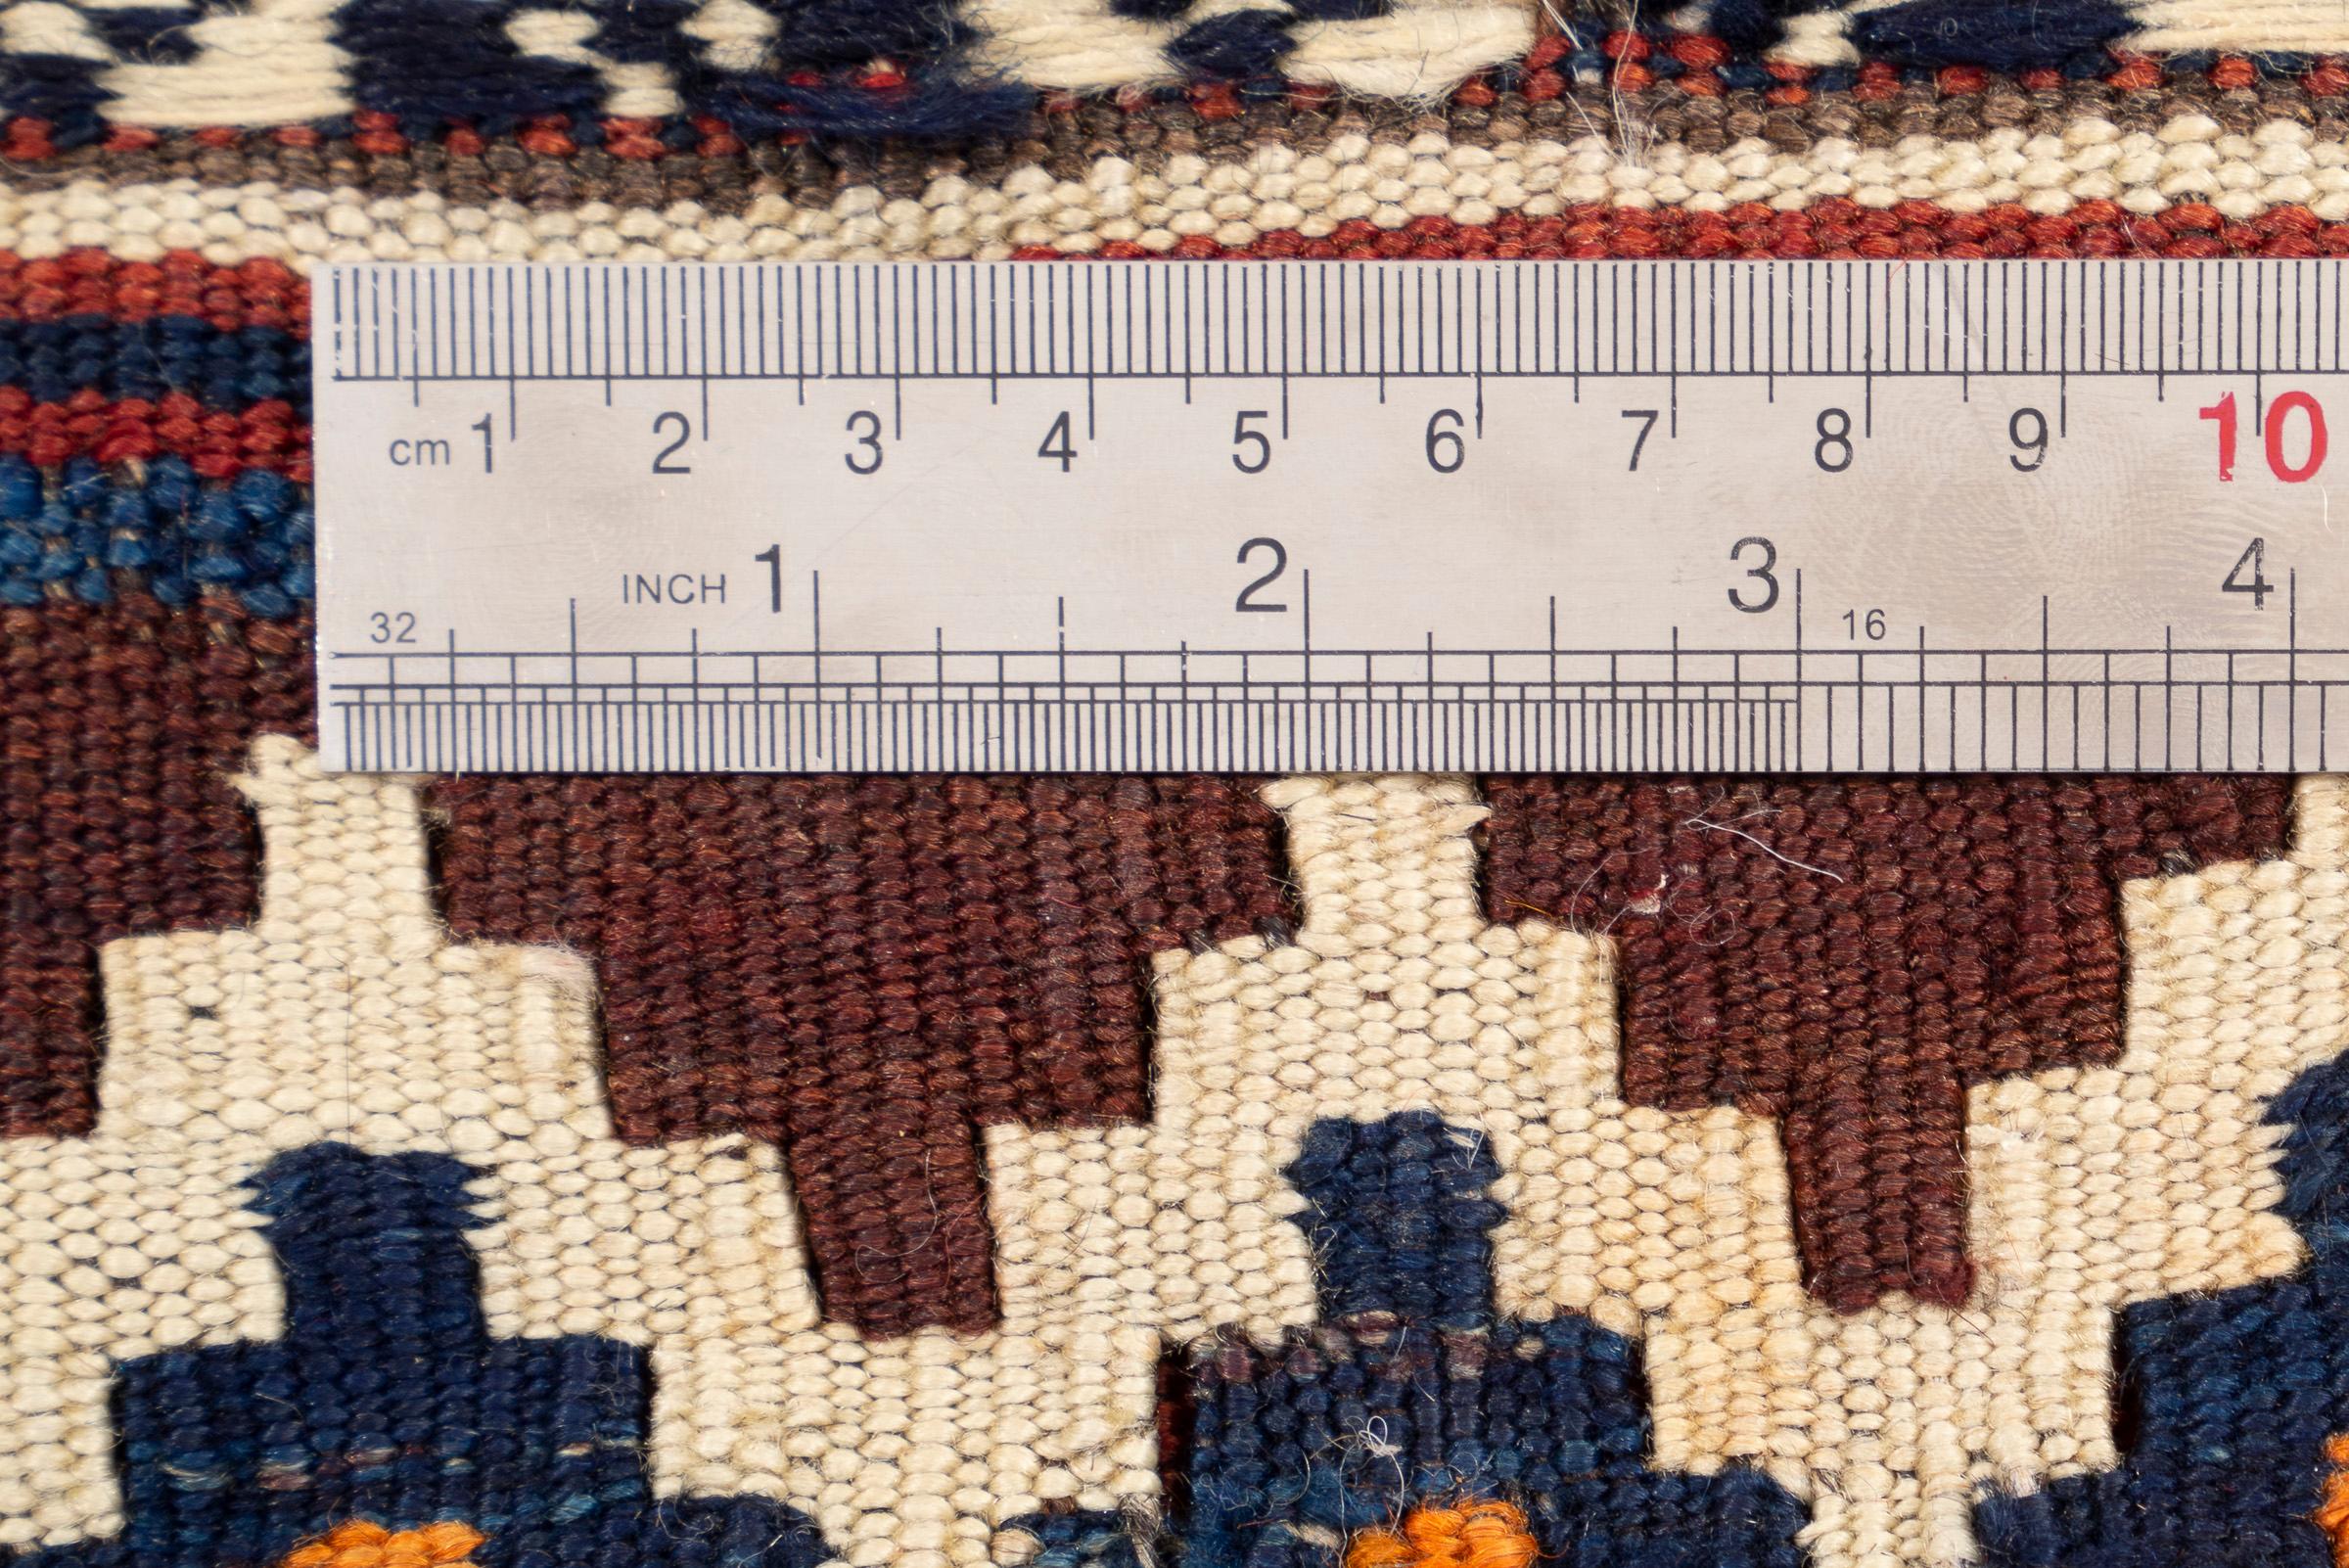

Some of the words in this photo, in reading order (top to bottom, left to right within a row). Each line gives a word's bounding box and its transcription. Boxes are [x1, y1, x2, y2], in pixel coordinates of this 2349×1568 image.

[390, 439, 450, 466] cm
[472, 413, 493, 474] 1
[652, 411, 691, 475] 2
[845, 410, 883, 475] 3
[1037, 410, 1078, 473] 4
[1232, 410, 1271, 475] 5
[1425, 408, 1465, 474] 6
[1621, 409, 1659, 472] 7
[1814, 407, 1854, 474] 8
[2008, 407, 2049, 472] 9
[2198, 391, 2328, 484] 10
[623, 574, 726, 604] INCH
[755, 543, 781, 614] 1
[1235, 536, 1288, 613] 2
[1727, 536, 1779, 614] 3
[2221, 537, 2275, 611] 4
[371, 612, 416, 642] 32
[1842, 608, 1886, 639] 16
